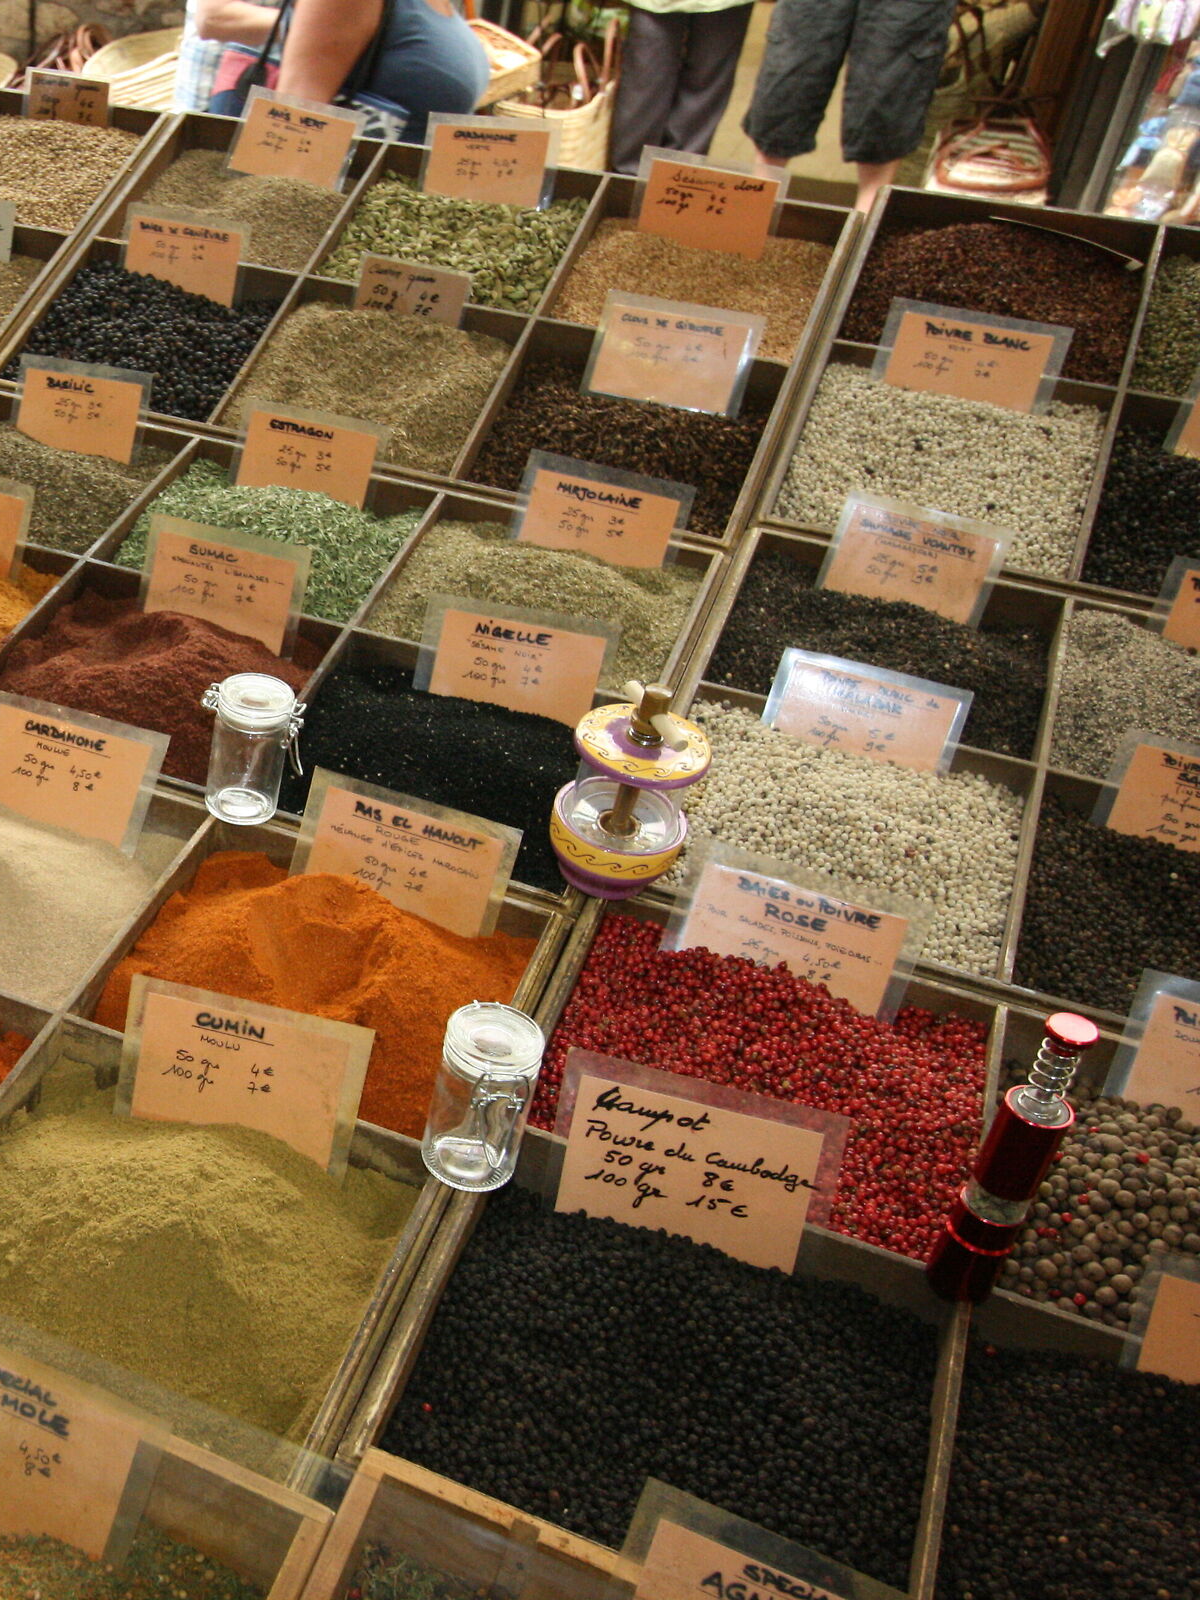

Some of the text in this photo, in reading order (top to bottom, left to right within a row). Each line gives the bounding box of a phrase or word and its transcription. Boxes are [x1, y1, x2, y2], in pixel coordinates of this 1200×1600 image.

[269, 419, 334, 439] ESTRAGON
[189, 544, 239, 563] SUMAC
[23, 752, 38, 765] 50
[11, 766, 33, 778] 100
[354, 800, 485, 851] RAS EL HANOUT
[375, 825, 422, 846] ROUGE
[764, 902, 828, 932] ROSE
[175, 1049, 199, 1066] 50
[162, 1067, 193, 1081] 100
[602, 1150, 634, 1166] 50
[664, 1142, 696, 1162] du
[704, 1151, 820, 1193] Cambodge
[584, 1169, 628, 1188] 100
